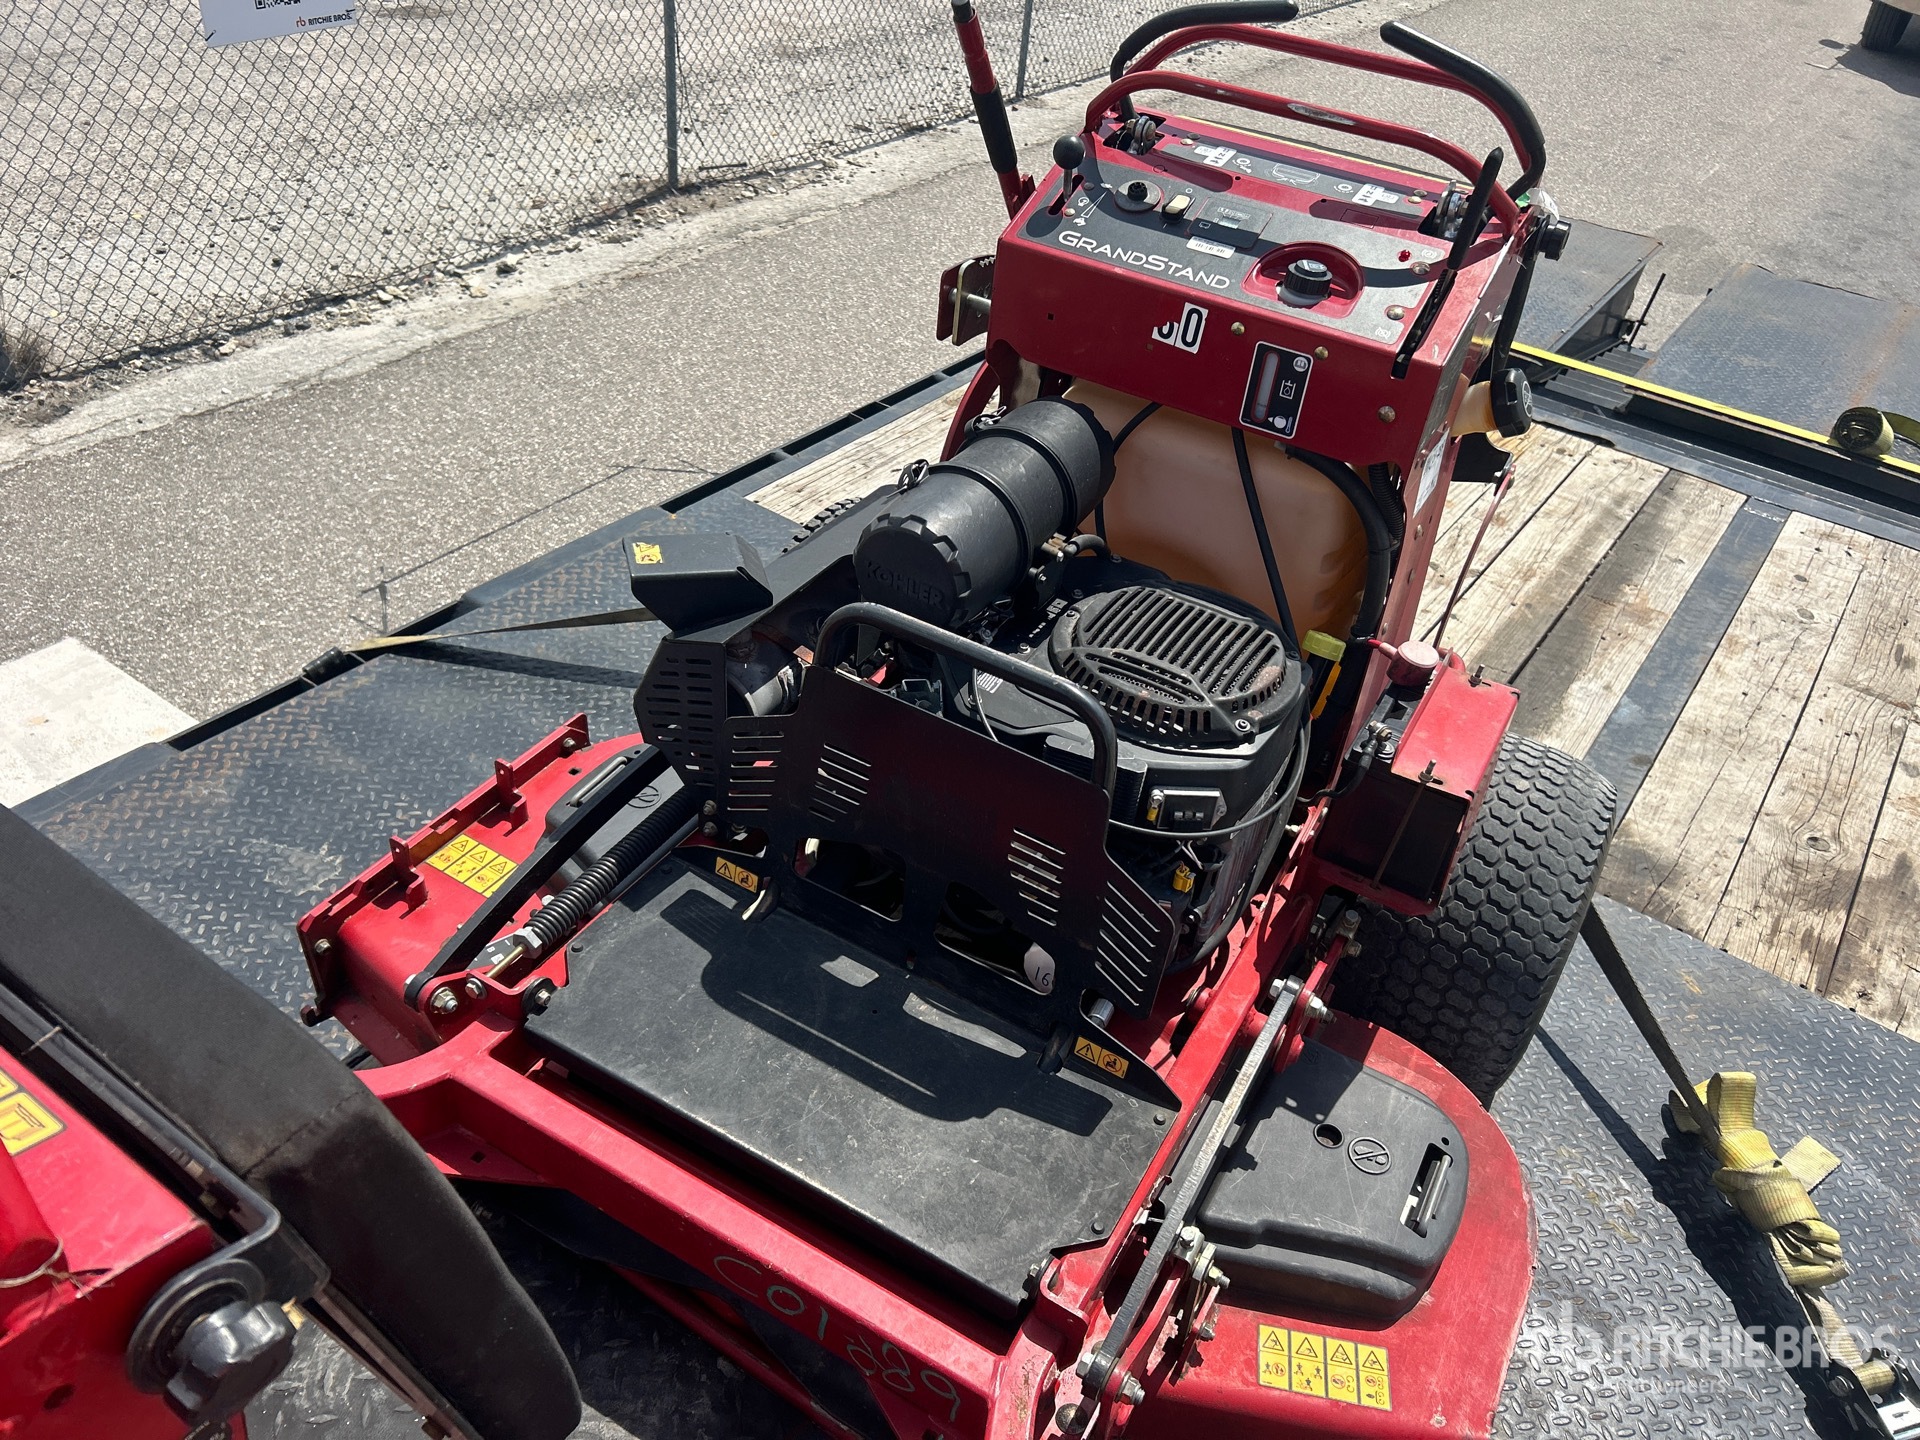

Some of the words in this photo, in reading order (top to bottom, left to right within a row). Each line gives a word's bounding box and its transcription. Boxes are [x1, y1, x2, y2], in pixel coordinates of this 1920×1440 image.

[308, 16, 333, 26] RITCHIE
[333, 13, 353, 22] BROS.
[866, 560, 948, 610] KOHLER
[1034, 966, 1052, 987] 16
